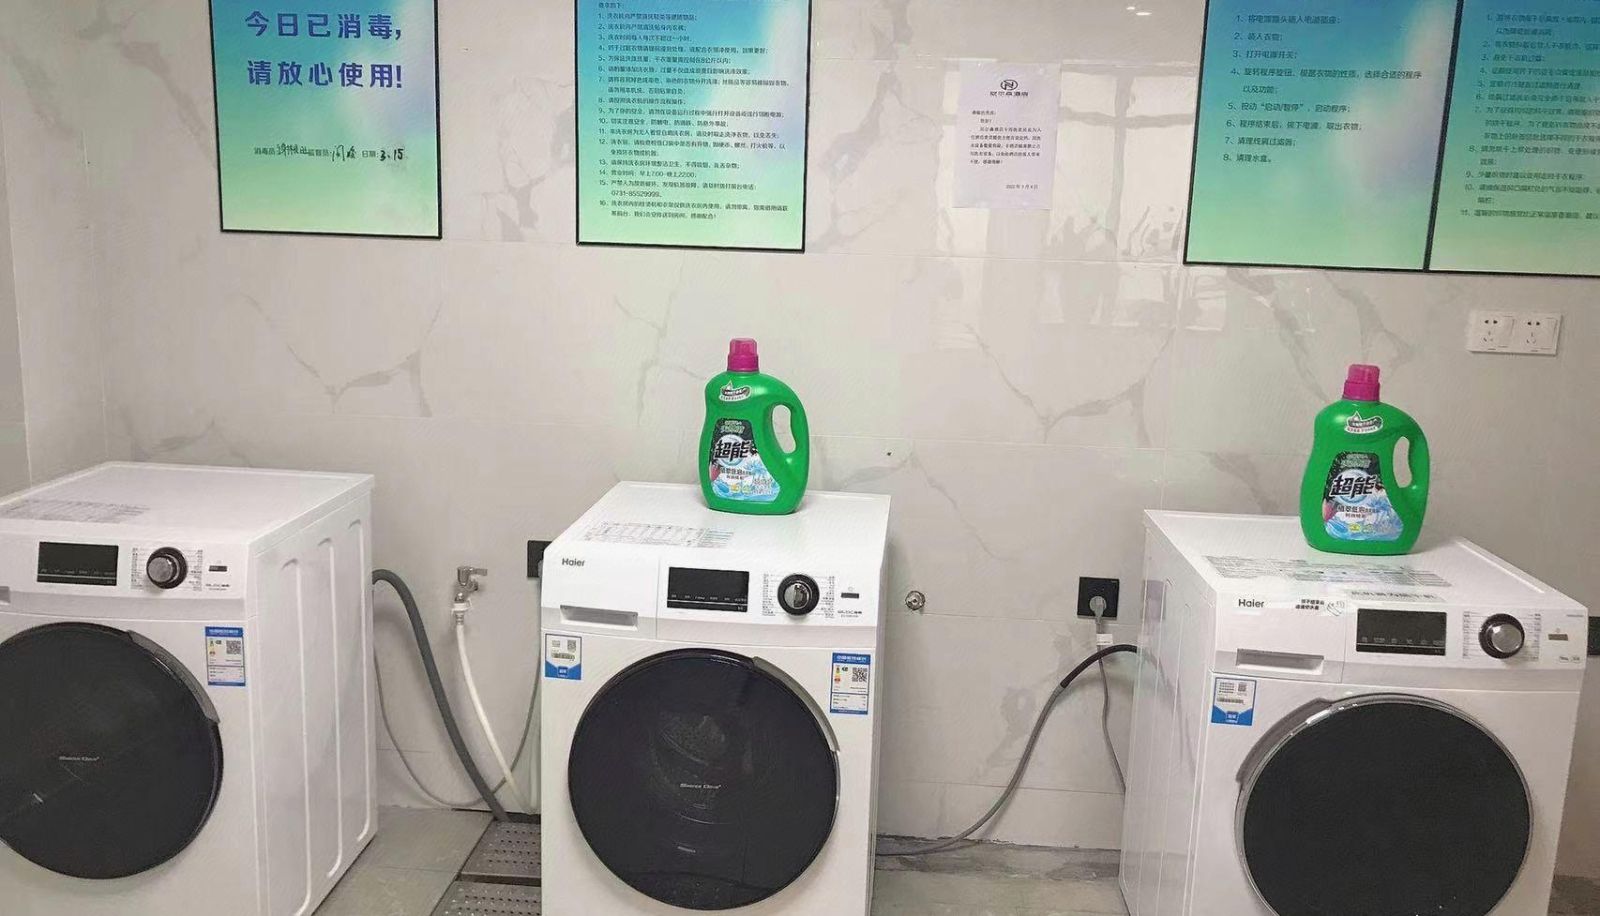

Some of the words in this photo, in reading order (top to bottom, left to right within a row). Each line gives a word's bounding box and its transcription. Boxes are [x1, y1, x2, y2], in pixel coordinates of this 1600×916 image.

[245, 10, 402, 40] 今日已消毒，
[247, 60, 402, 88] 请放心使用！
[713, 440, 751, 462] 超能
[1328, 475, 1377, 499] 超能
[561, 557, 585, 567] Haier
[1238, 598, 1265, 608] Haier
